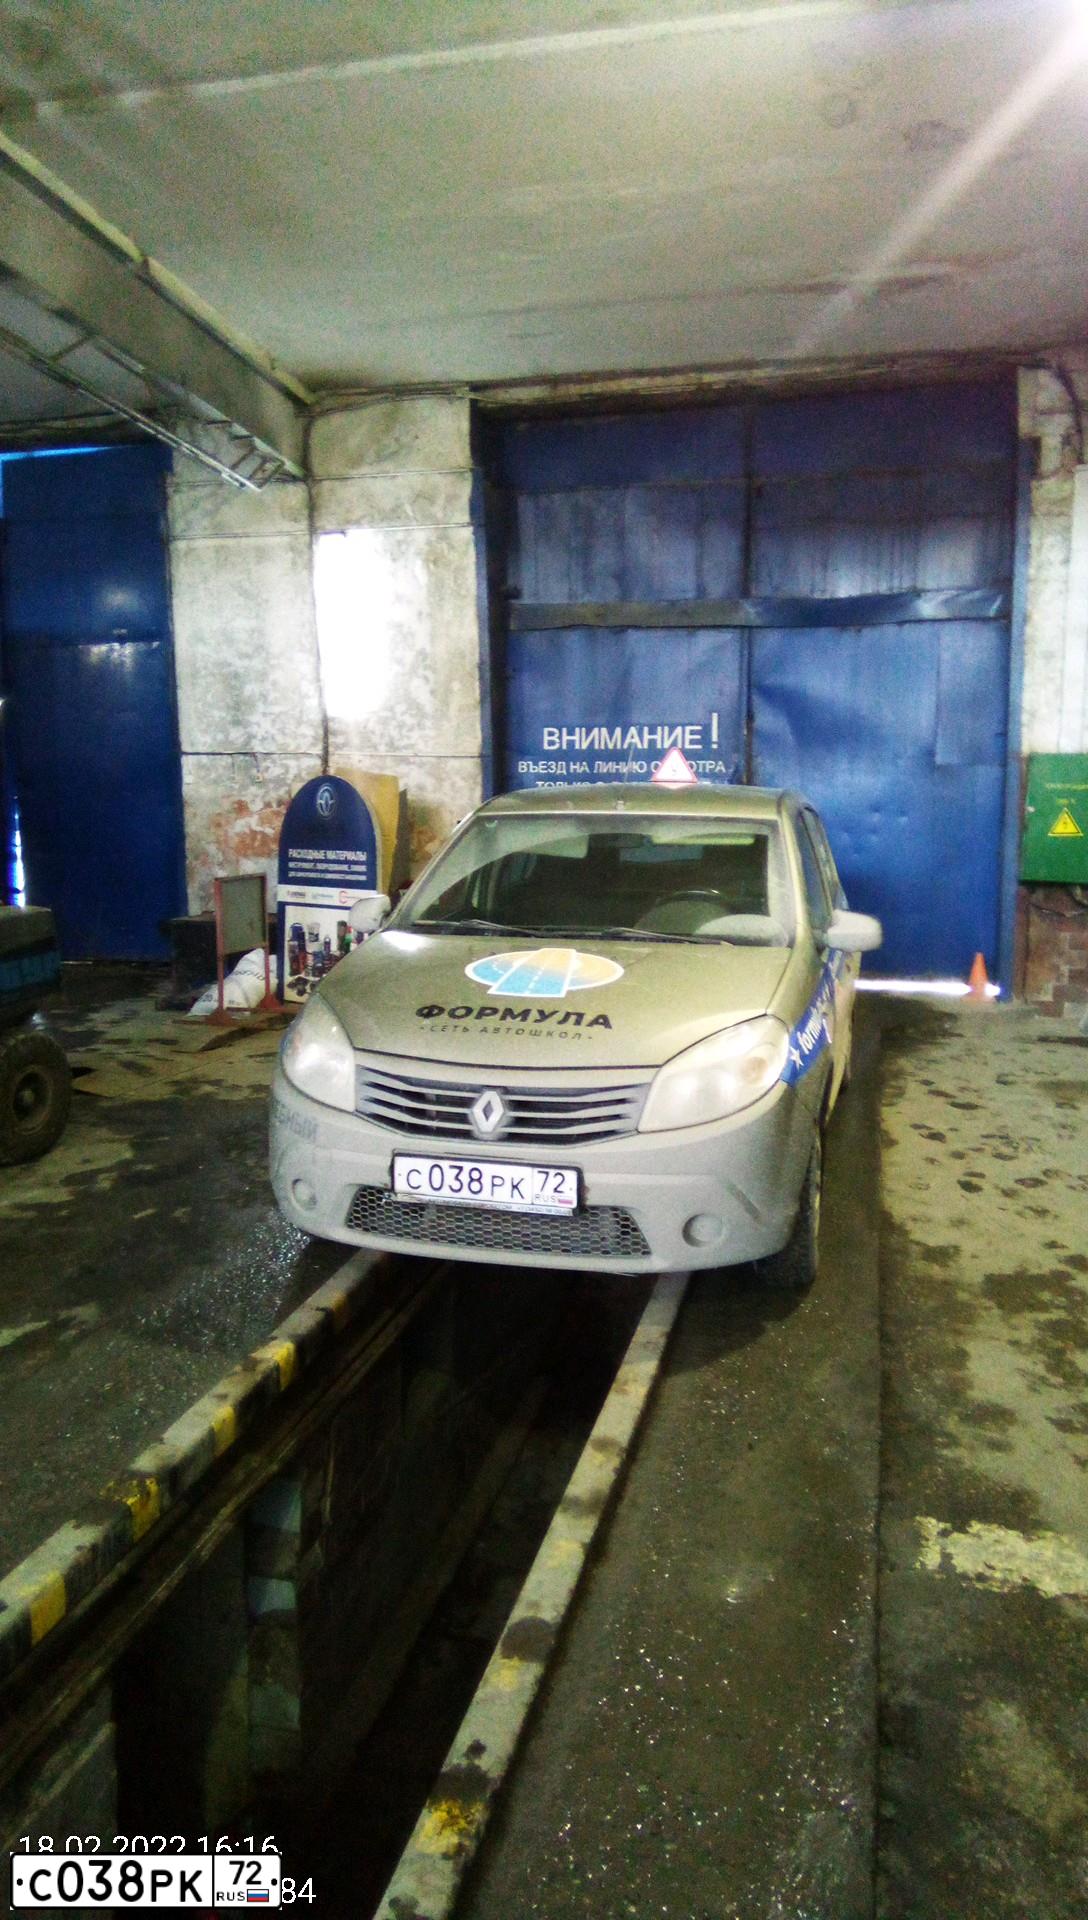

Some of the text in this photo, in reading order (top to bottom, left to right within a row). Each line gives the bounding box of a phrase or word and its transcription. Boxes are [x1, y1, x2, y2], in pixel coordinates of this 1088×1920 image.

[543, 726, 703, 750] ВНИМАНИЕ
[518, 760, 727, 775] ВЪЕЗД НА ЛИНИЮ ООТРА
[415, 1004, 613, 1029] ФОРМУЛА
[535, 1194, 557, 1203] RUS
